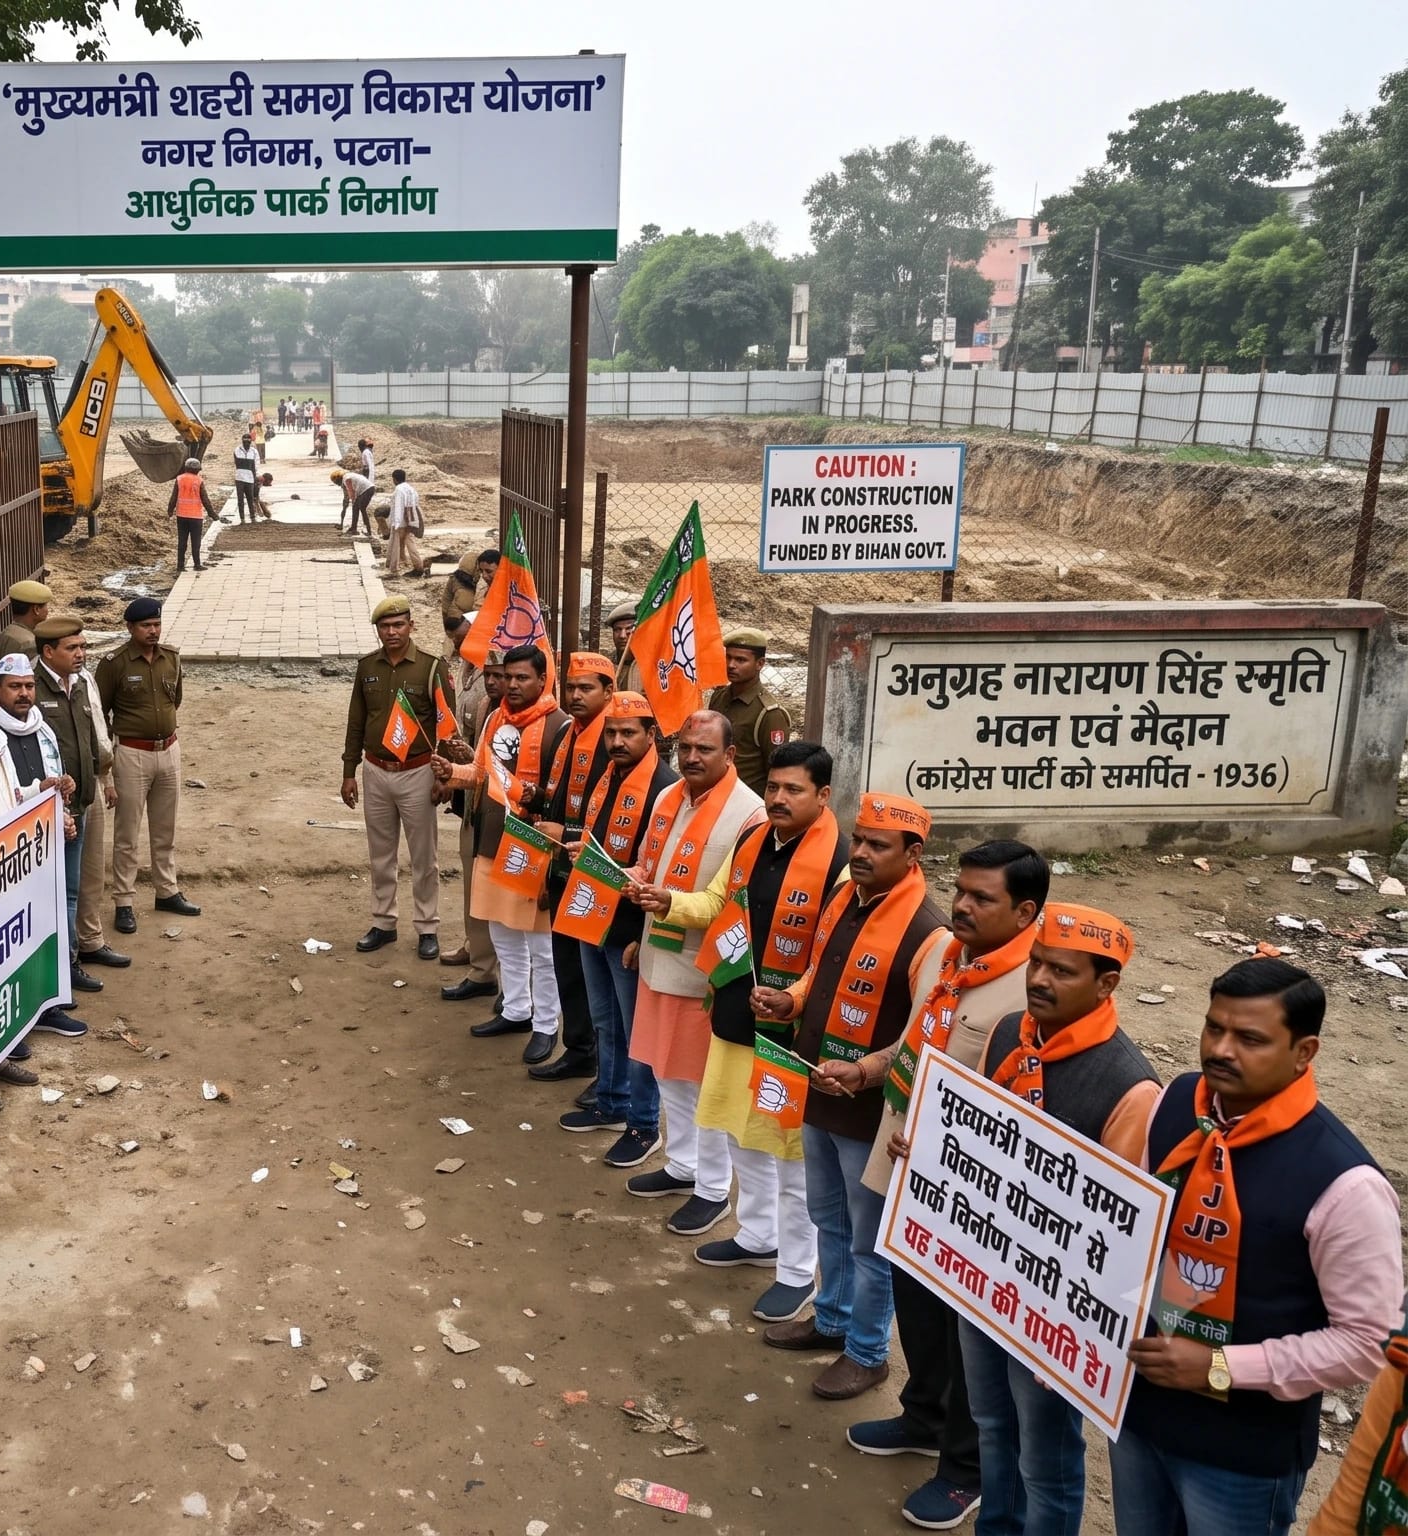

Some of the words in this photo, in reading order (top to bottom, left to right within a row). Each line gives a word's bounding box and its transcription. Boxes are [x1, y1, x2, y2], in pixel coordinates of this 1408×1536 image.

[170, 72, 251, 117] शहरी
[264, 82, 353, 122] समग्र
[362, 70, 473, 115] विकास
[484, 68, 606, 115] योजना’
[141, 139, 215, 169] नगर
[223, 129, 323, 171] निगम,
[126, 180, 256, 231] आधुनिक
[266, 177, 329, 216] पार्क
[340, 177, 436, 216] निर्माण
[83, 379, 107, 436] JCB
[815, 455, 905, 478] CAUTION
[771, 488, 816, 507] PARK
[821, 486, 953, 506] CONSTRUCTION
[802, 516, 821, 534] IN
[825, 514, 917, 533] PROGRESS.
[769, 543, 827, 561] FUNDED
[833, 543, 852, 560] BY
[855, 542, 901, 560] BIHAN
[905, 541, 946, 559] GOVT.
[888, 662, 1003, 709] अनुग्रह
[1015, 661, 1148, 695] नारायण
[1157, 649, 1227, 698] सिंह
[1235, 647, 1329, 706] स्मृति
[976, 715, 1060, 747] भवन
[1071, 705, 1119, 749] एवं
[1131, 700, 1230, 751] मैदान
[1002, 756, 1054, 789] पार्टी
[1060, 757, 1095, 789] को
[1102, 756, 1190, 789] समर्पित
[1213, 755, 1289, 793] 1936)
[787, 889, 809, 907] JP
[782, 913, 807, 928] JP
[856, 953, 878, 972] JP
[848, 978, 874, 996] JP
[940, 1133, 1002, 1202] विकास
[1006, 1180, 1082, 1251] योजना’
[1087, 1229, 1109, 1275] से
[1025, 1137, 1078, 1197] शहरी
[1082, 1174, 1140, 1237] समग्र
[1200, 1184, 1224, 1210] J
[1183, 1213, 1229, 1244] JP
[910, 1168, 949, 1213] पार्क
[1015, 1243, 1062, 1300] जारी
[1067, 1277, 1128, 1350] रहेगा।
[935, 1238, 989, 1300] जनता
[992, 1281, 1020, 1325] की
